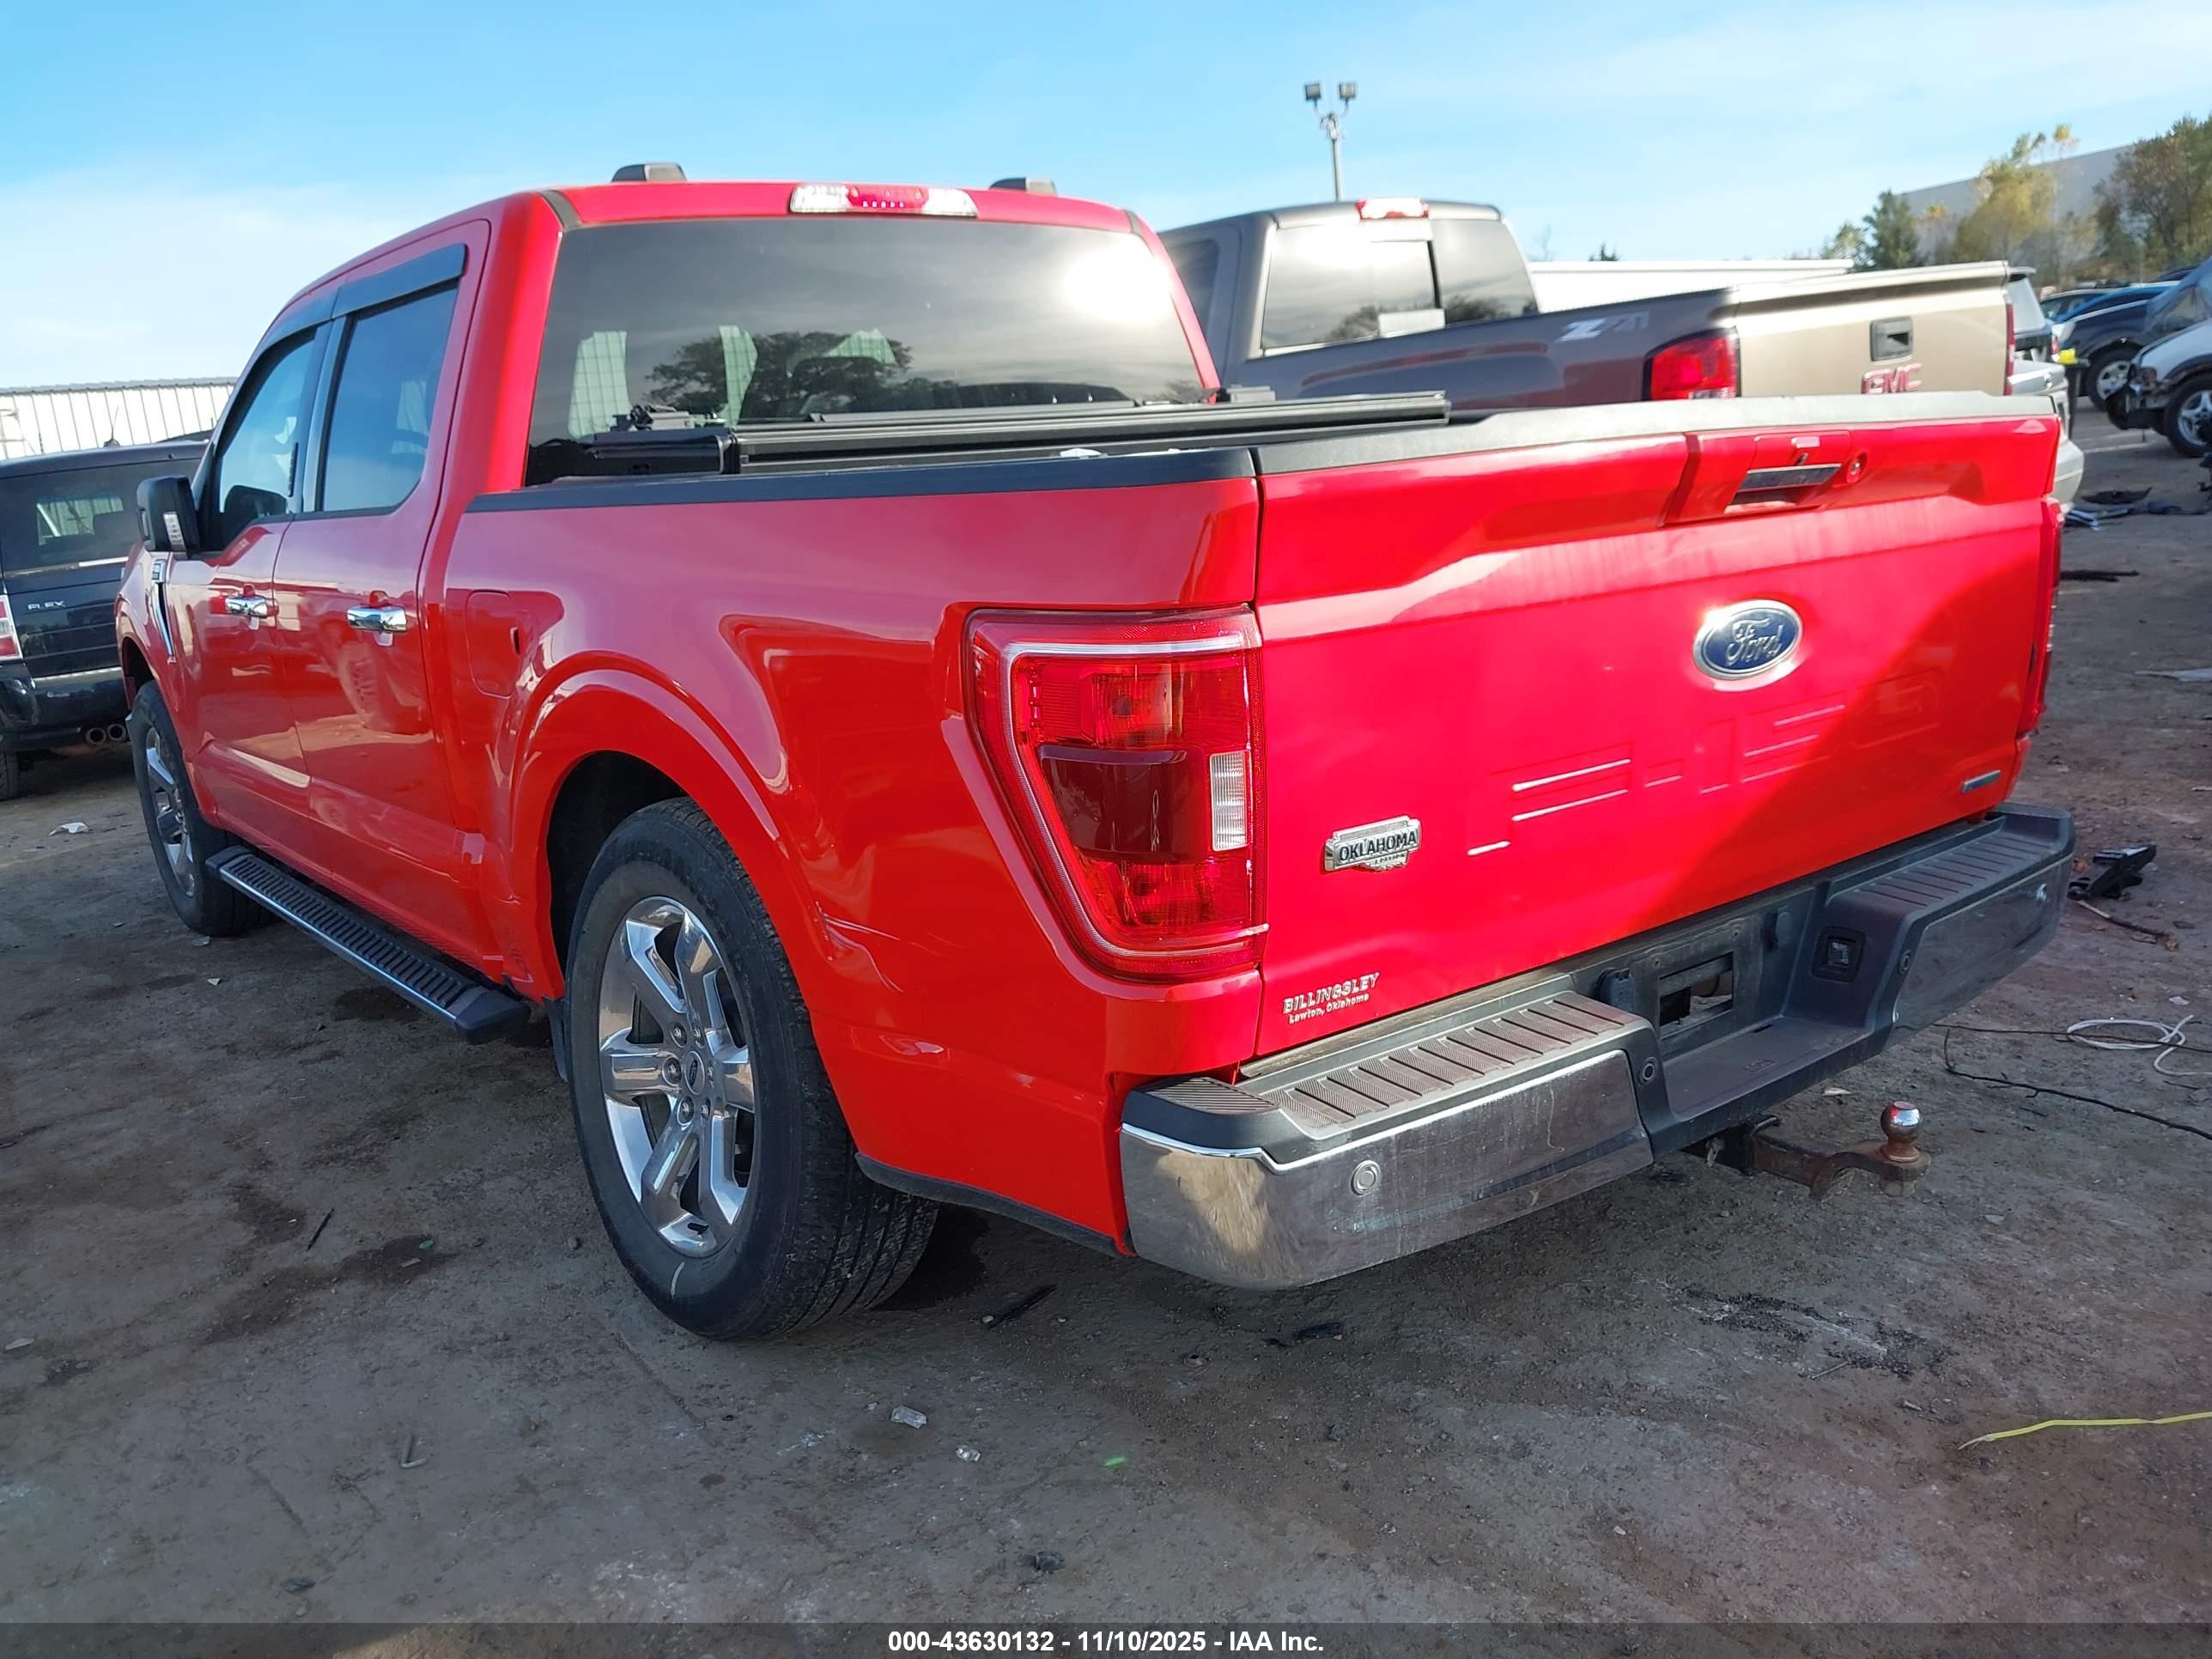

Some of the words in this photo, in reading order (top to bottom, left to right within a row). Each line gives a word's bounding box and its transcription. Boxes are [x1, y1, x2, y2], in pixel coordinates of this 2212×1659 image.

[1861, 362, 1923, 394] GMC
[1726, 617, 1784, 666] Ford
[1339, 830, 1417, 861] OKLAHOMA
[1283, 971, 1380, 1013] BILLINGSLEY
[1288, 1007, 1326, 1024] Lawton,
[1326, 993, 1370, 1012] Oklahoma
